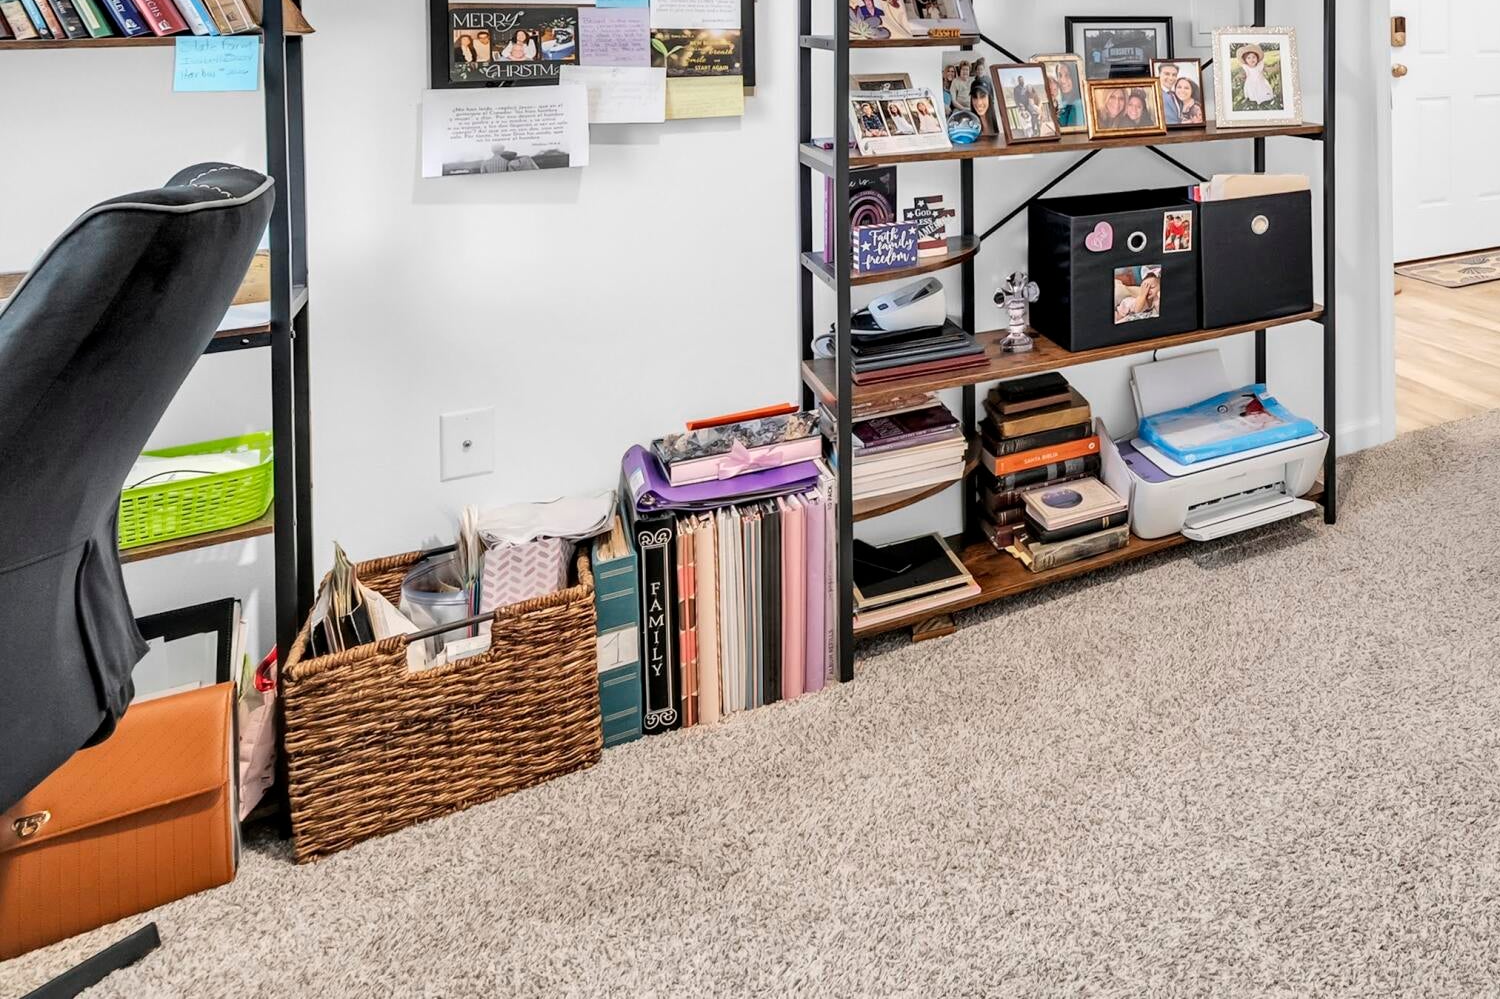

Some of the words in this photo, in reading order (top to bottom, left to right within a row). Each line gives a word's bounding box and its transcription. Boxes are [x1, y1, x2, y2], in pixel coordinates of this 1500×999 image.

[453, 10, 525, 33] MERRY
[1109, 47, 1135, 57] HERSHEY'S
[712, 64, 729, 72] AGAIN
[868, 226, 899, 247] Faith
[873, 230, 915, 256] family
[861, 250, 910, 271] freedom
[1023, 455, 1041, 465] SANTA
[1042, 451, 1059, 461] BIBLIA
[826, 485, 834, 500] PACK
[648, 582, 665, 677] FAMILY
[604, 632, 623, 666] 1
